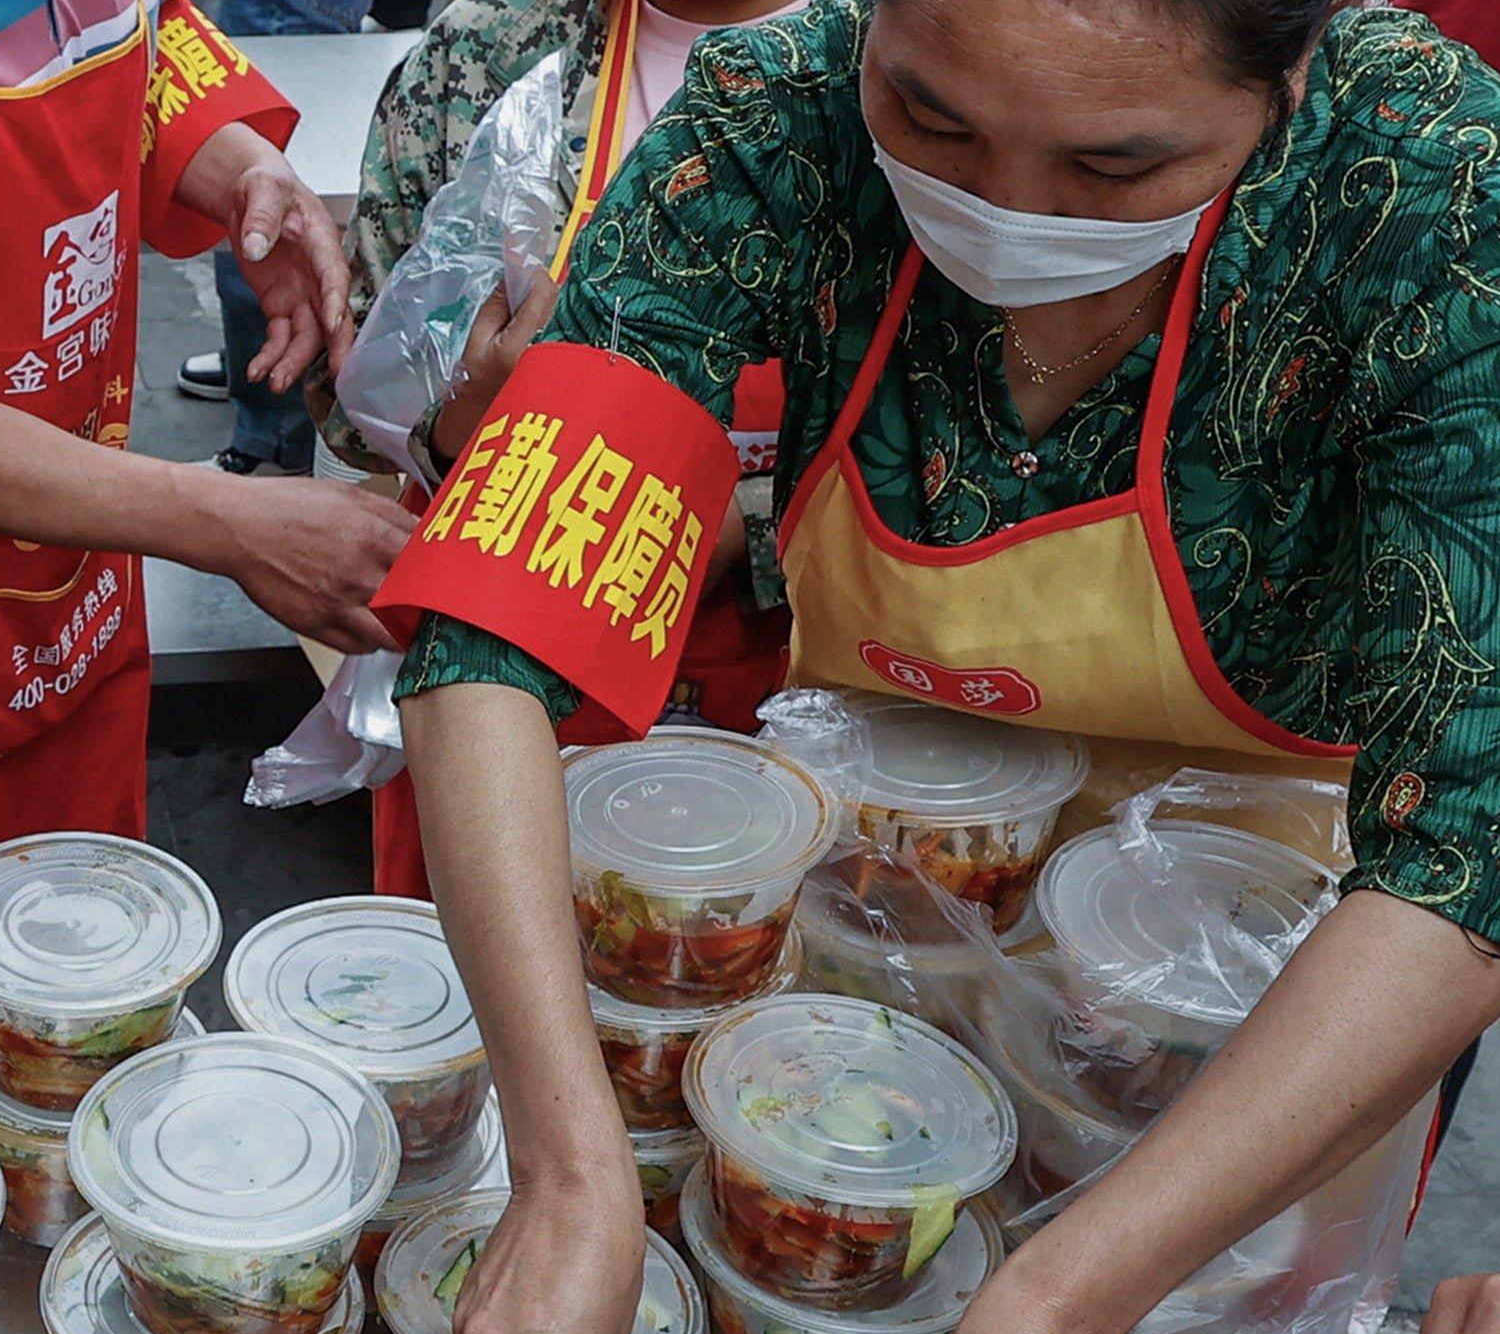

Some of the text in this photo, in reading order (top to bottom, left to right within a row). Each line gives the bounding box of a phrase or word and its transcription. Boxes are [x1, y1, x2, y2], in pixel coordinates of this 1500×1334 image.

[11, 567, 121, 676] 全国服务热线
[421, 411, 704, 661] 后勤保障员
